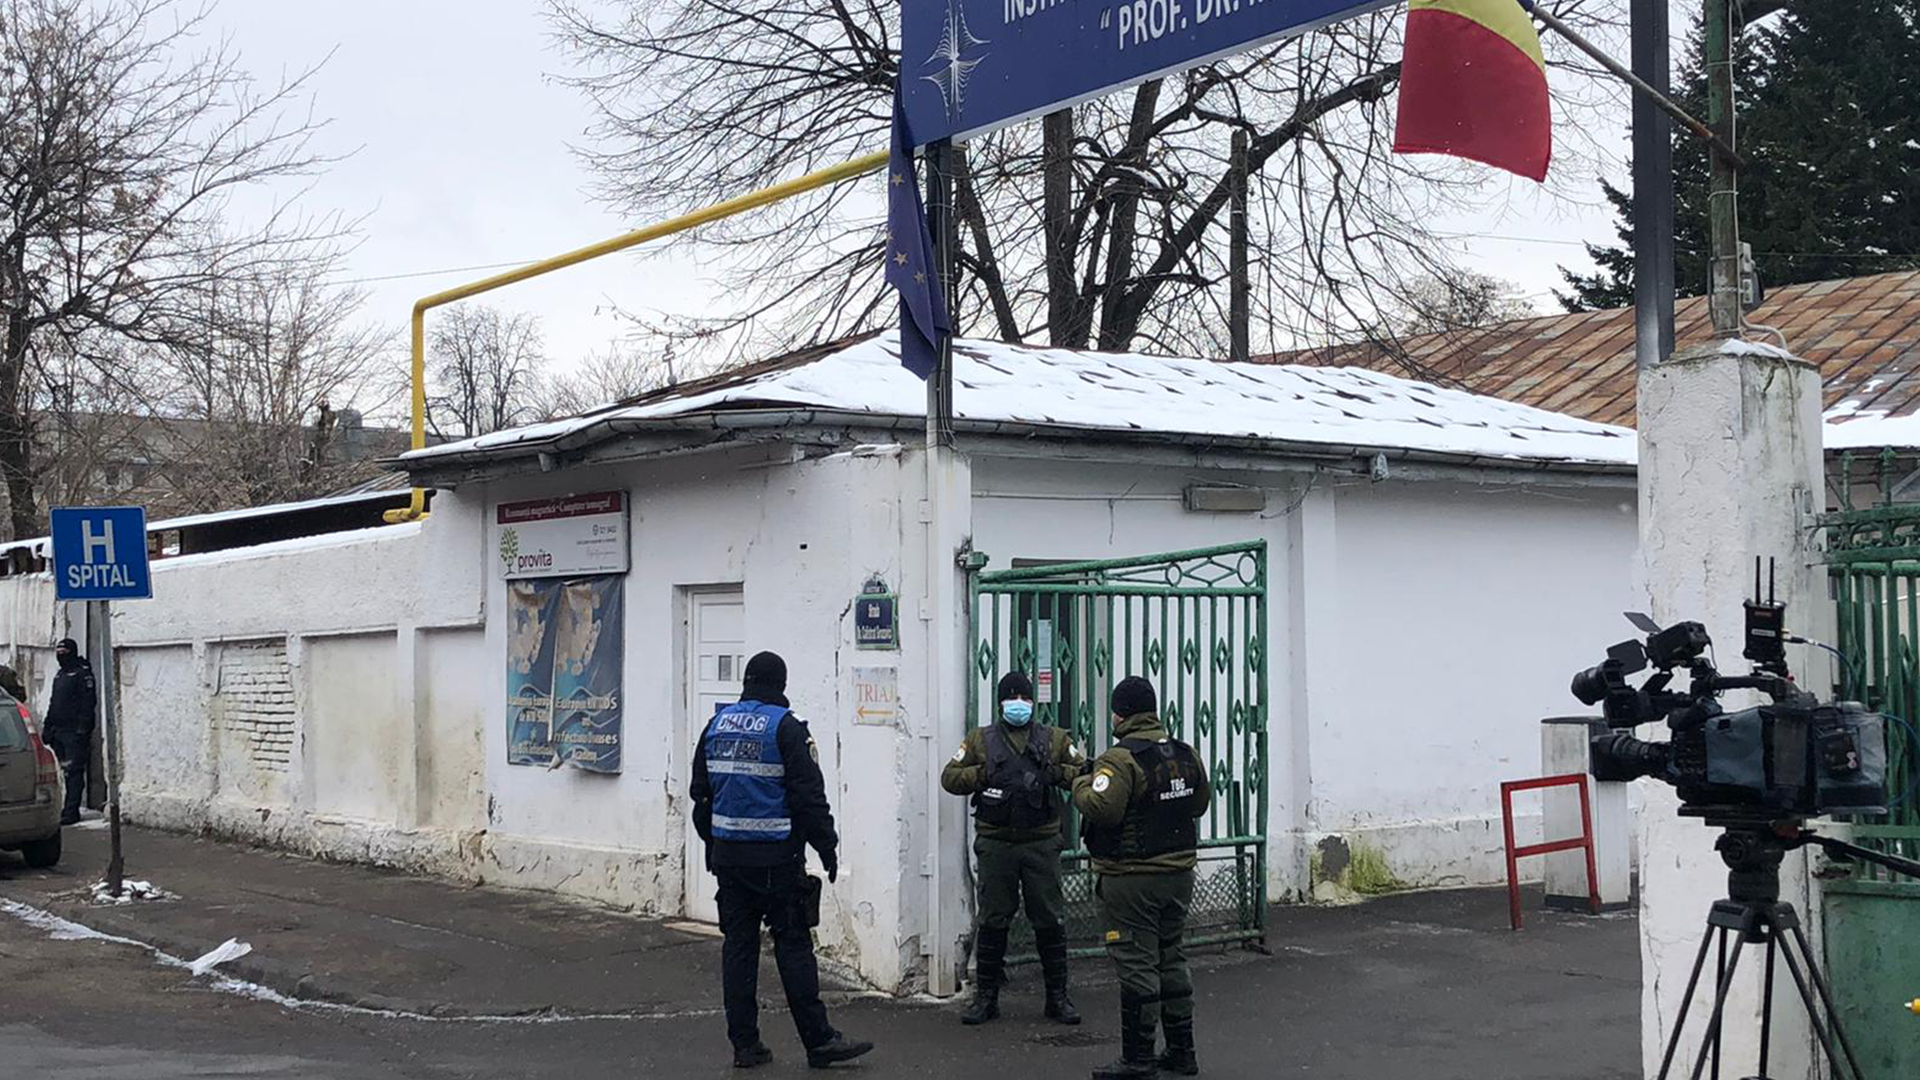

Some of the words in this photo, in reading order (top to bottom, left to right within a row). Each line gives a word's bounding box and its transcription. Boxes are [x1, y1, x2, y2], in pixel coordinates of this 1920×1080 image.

[1119, 0, 1187, 50] PROF.
[82, 519, 115, 564] H
[518, 549, 553, 569] provita
[68, 564, 136, 589] SPITAL
[717, 713, 767, 732] DIALOG
[1160, 788, 1194, 800] SECURITY
